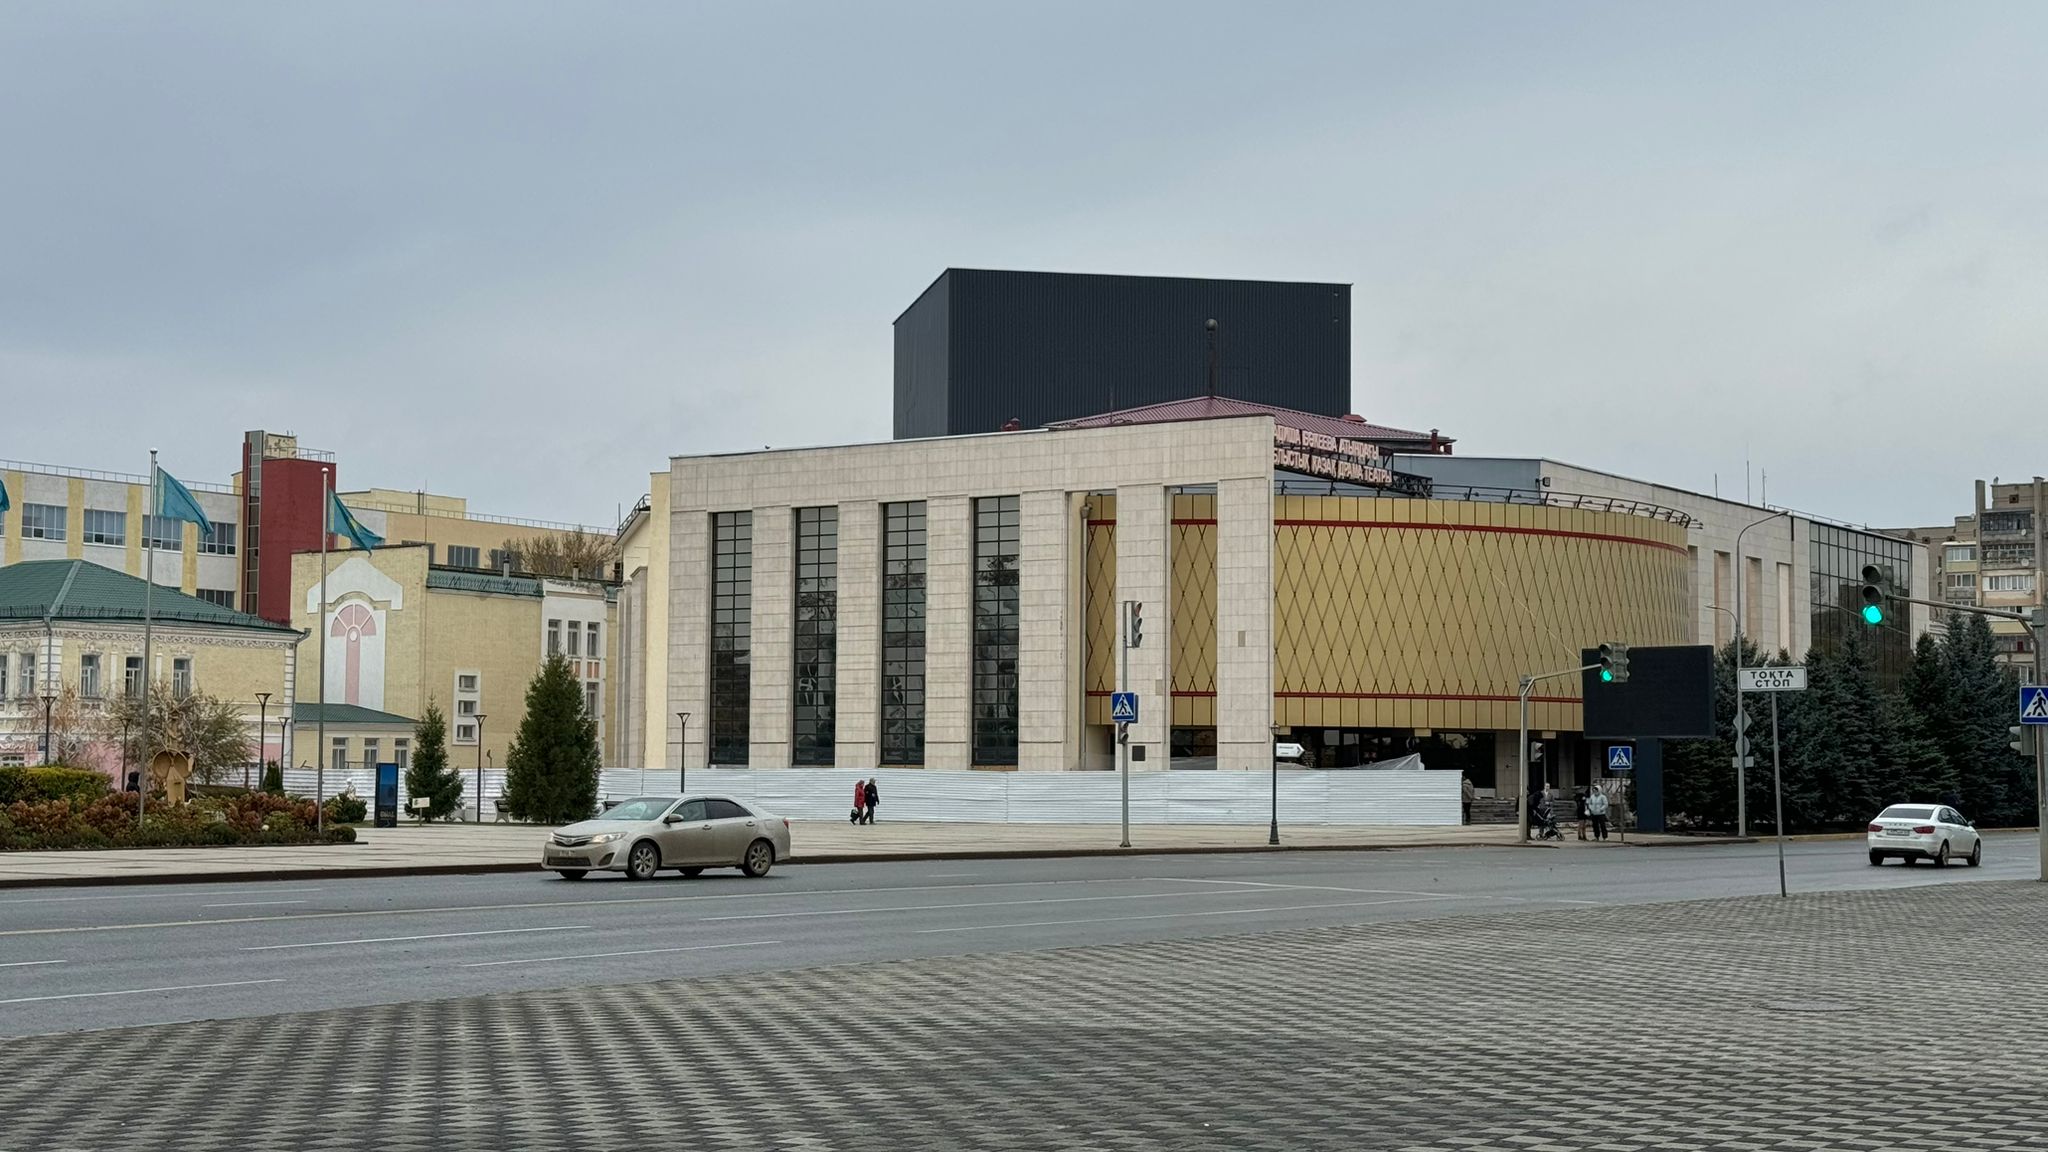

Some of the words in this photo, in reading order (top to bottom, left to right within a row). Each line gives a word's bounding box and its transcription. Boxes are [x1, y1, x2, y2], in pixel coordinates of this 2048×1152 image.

[1338, 461, 1363, 480] ДРАМА
[1363, 465, 1392, 483] ТЕАТРЫ
[1750, 670, 1794, 680] ТОҚТА
[1755, 679, 1790, 688] СТОП
